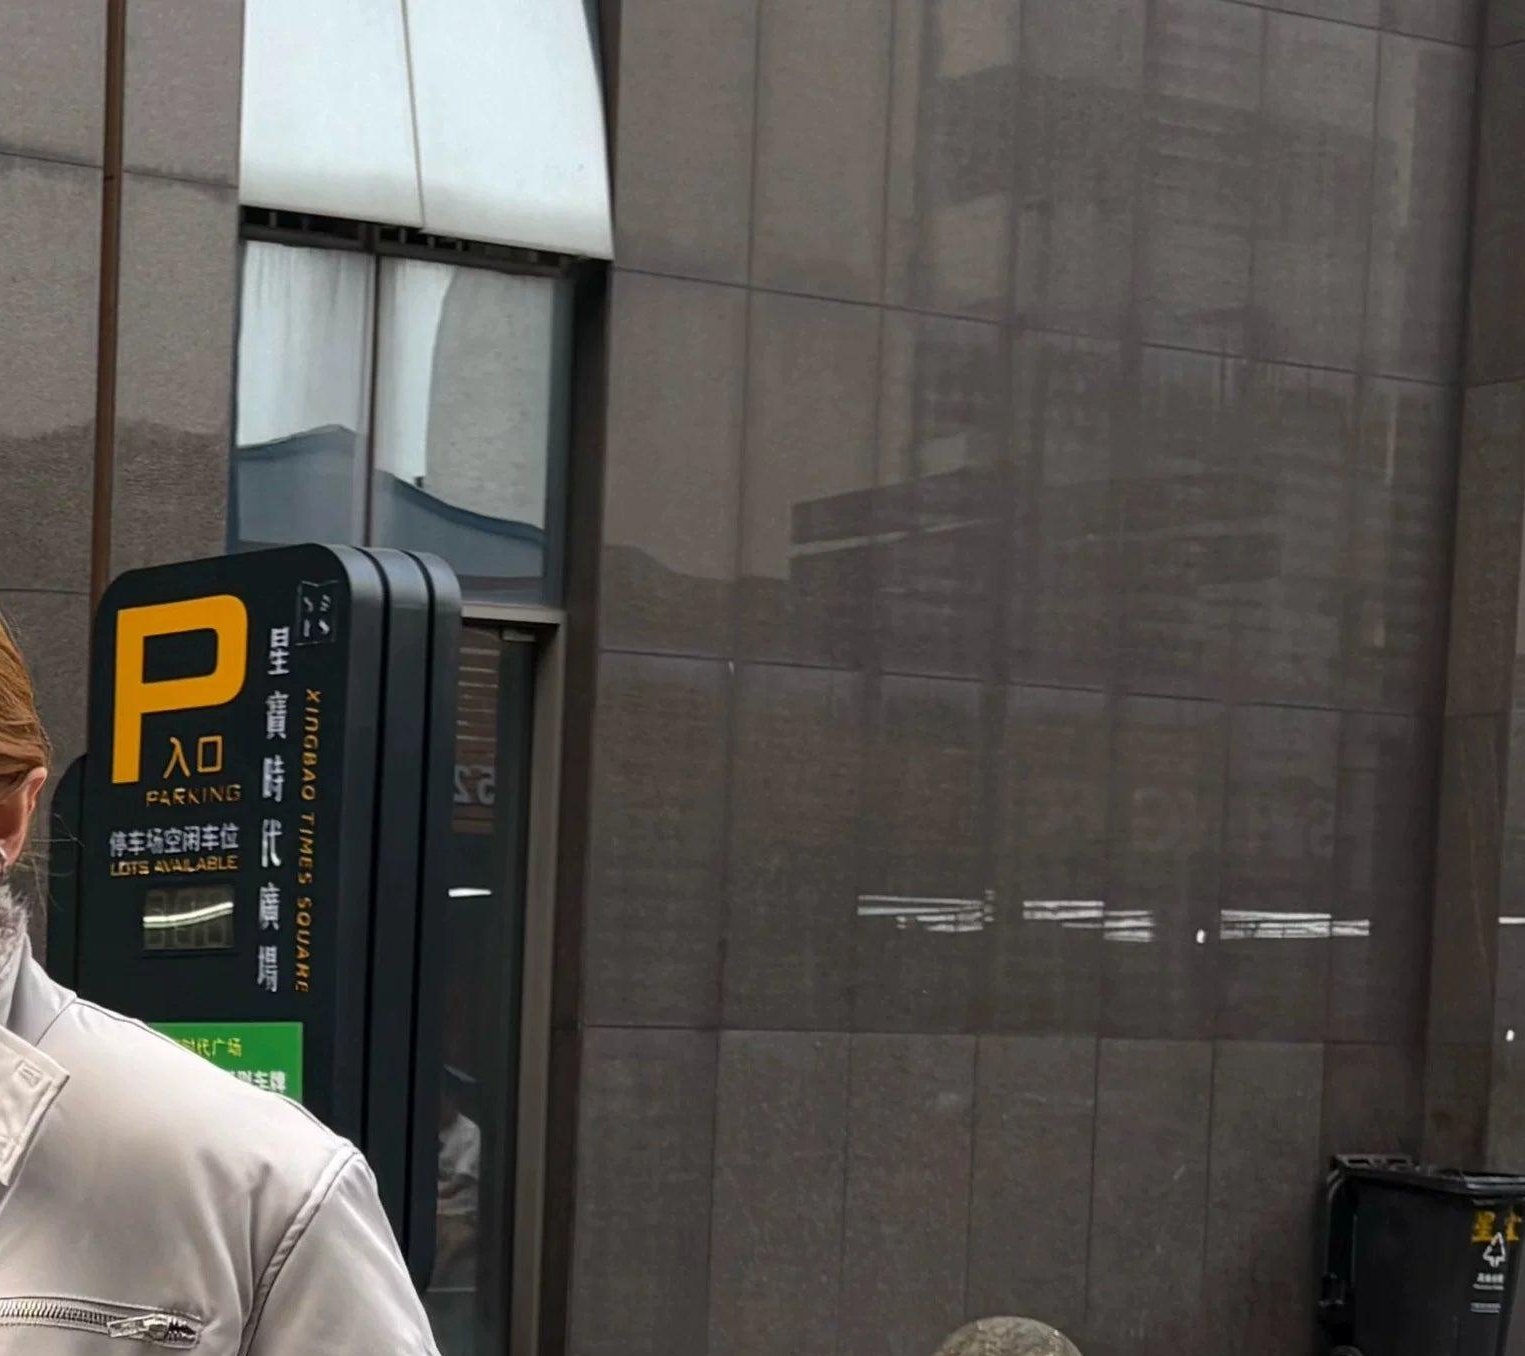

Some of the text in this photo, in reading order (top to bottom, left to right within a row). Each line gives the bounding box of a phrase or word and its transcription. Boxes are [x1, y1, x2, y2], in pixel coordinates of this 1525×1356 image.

[111, 593, 249, 784] P
[163, 735, 223, 779] 入口
[145, 784, 242, 807] PARKING
[110, 822, 240, 857] 停车场空闲车位
[294, 688, 321, 993] XINGBAO TIMES SQUARE
[110, 855, 239, 876] LOTS AVAILABLE
